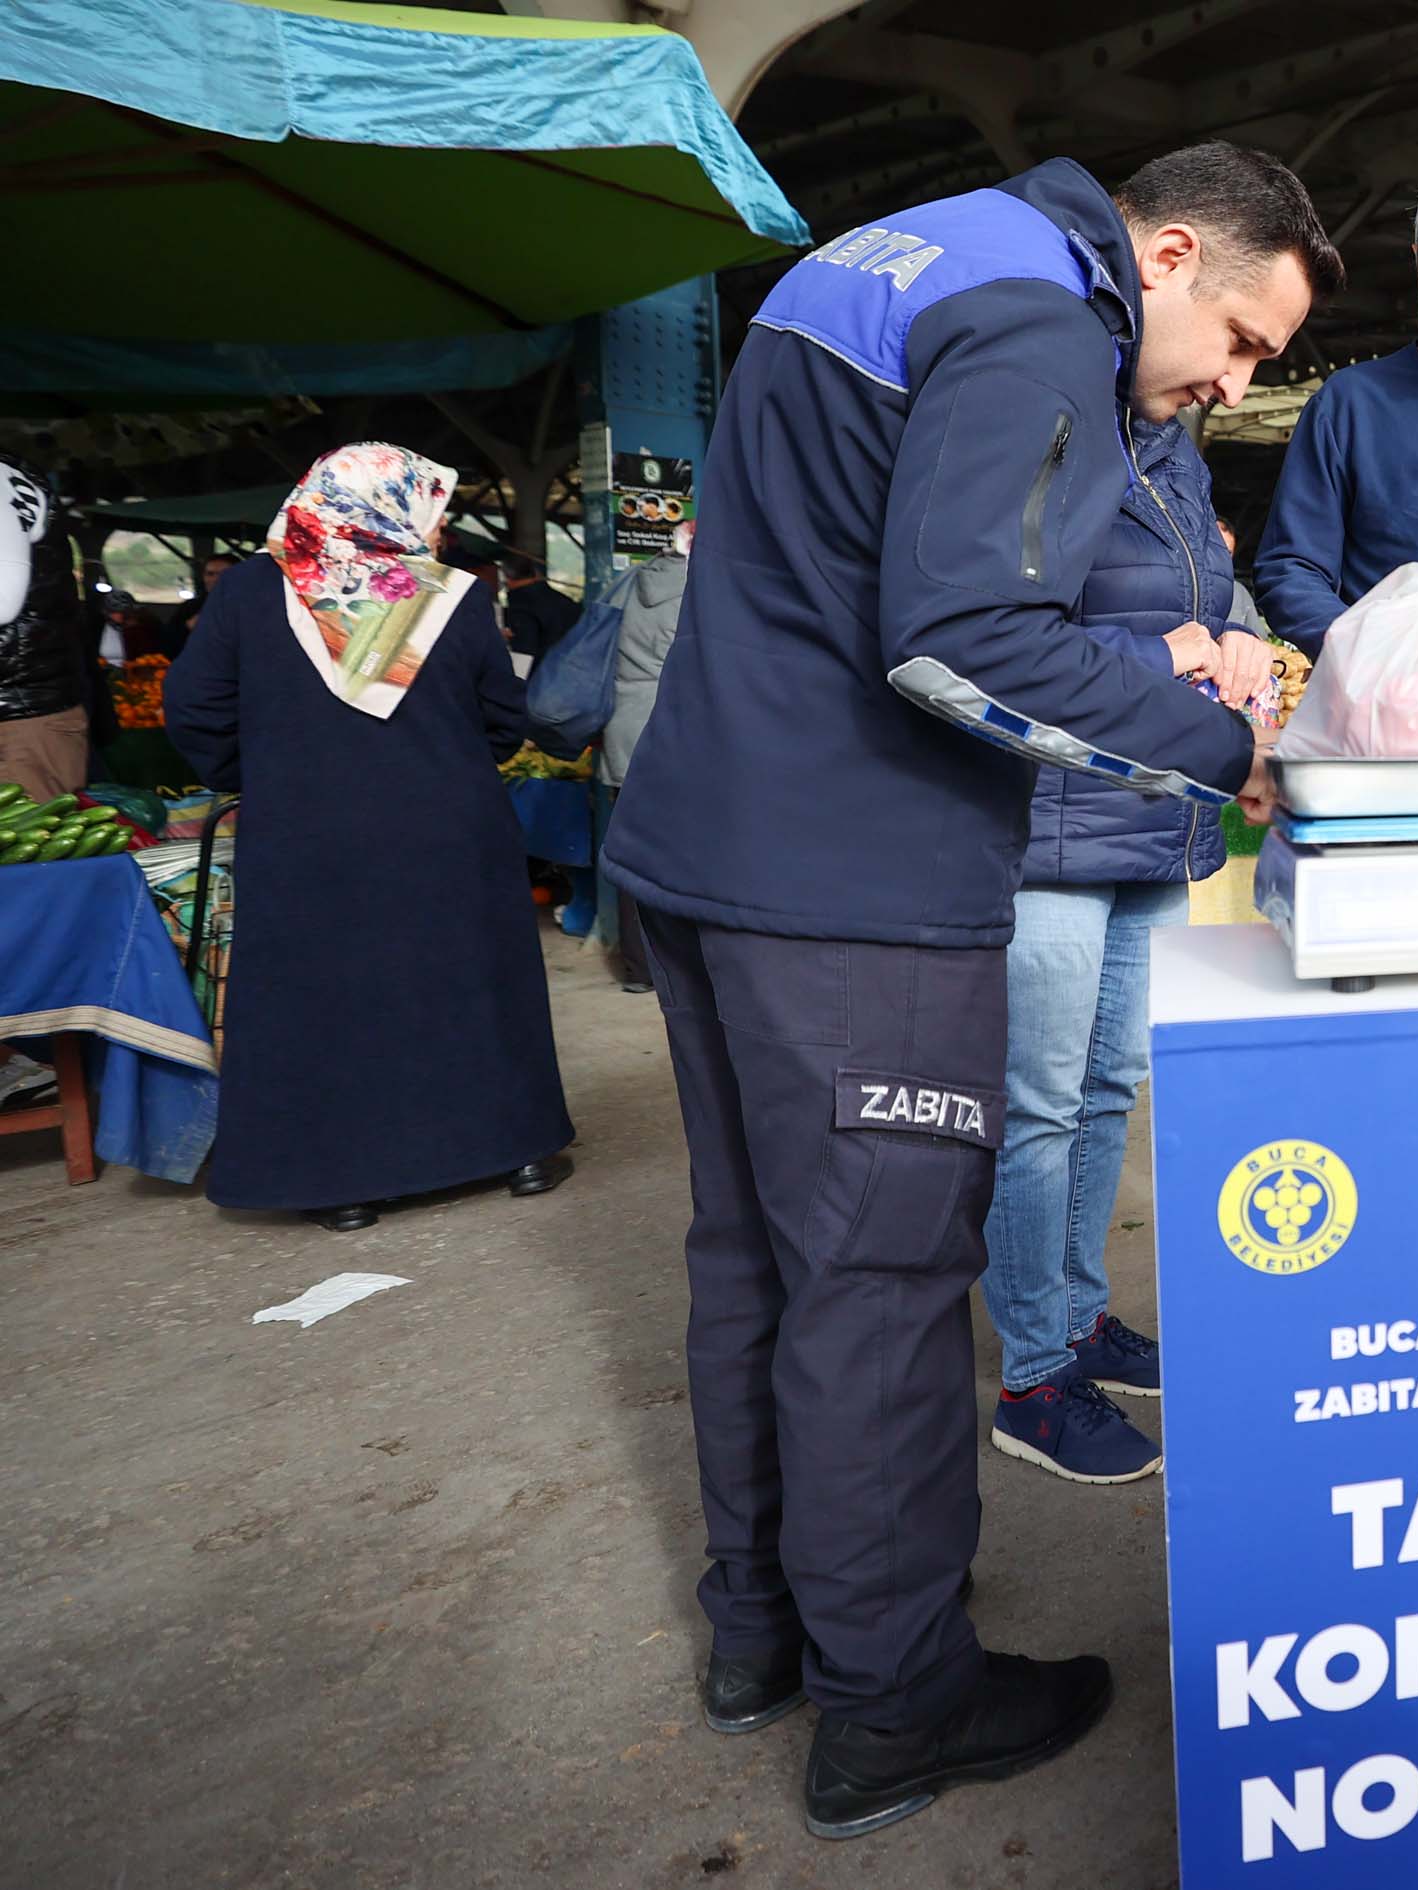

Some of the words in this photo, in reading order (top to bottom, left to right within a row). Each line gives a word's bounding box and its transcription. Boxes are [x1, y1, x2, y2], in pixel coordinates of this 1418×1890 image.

[804, 227, 945, 292] ABITA
[860, 1084, 986, 1138] ZABITA
[1246, 1146, 1327, 1173] BUCA
